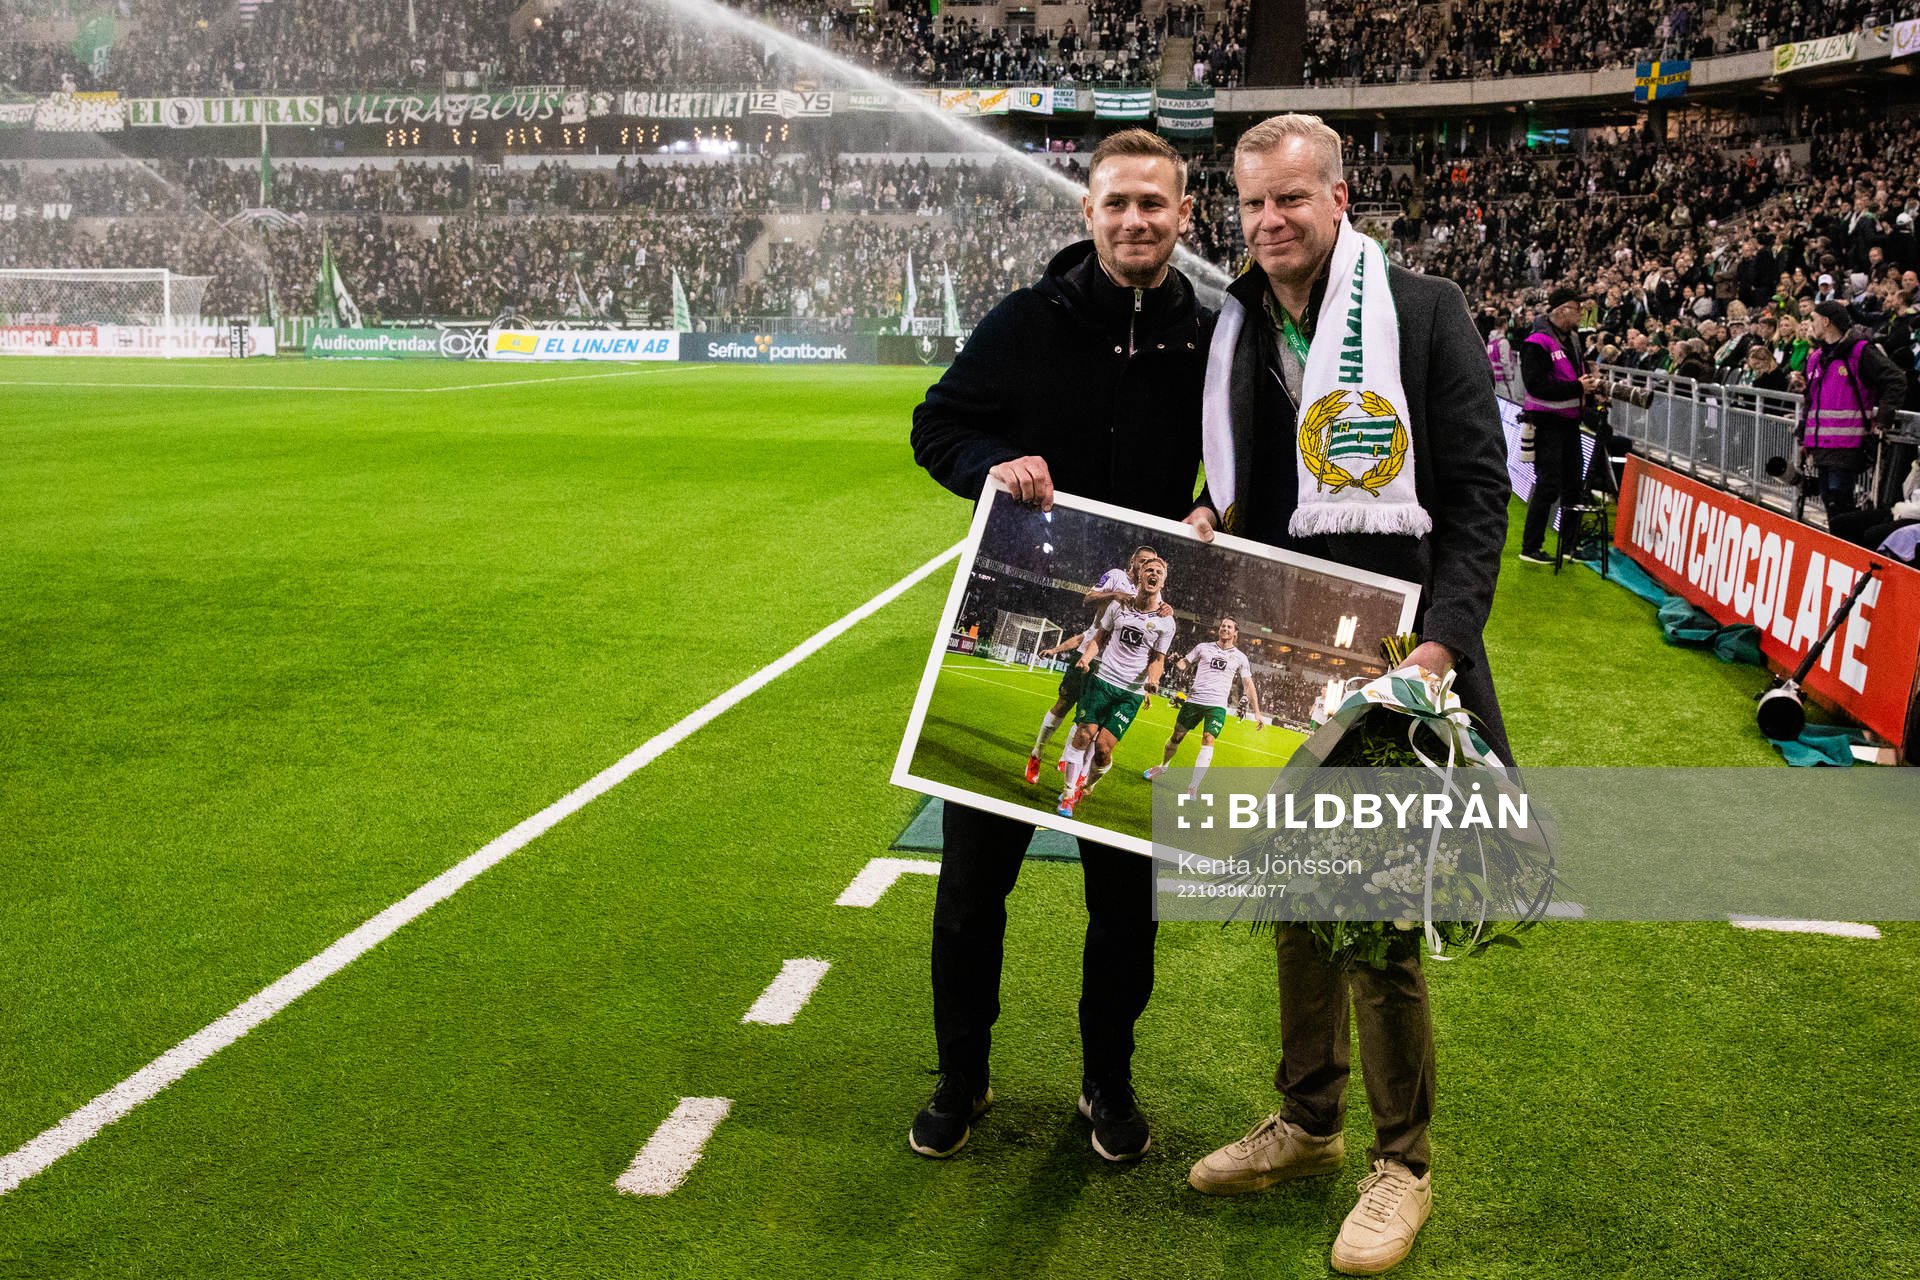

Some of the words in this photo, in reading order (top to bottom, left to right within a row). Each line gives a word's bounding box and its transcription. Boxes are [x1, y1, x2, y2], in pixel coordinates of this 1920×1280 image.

[1793, 32, 1854, 66] BAJEN
[202, 98, 320, 124] ULTRAS
[343, 95, 444, 124] ULTRA
[470, 94, 559, 122] BOYS
[312, 334, 437, 351] AudicomPendax
[544, 338, 565, 353] EL
[572, 338, 639, 353] LINJEN
[642, 338, 670, 353] AB
[707, 341, 757, 359] Sefina
[769, 343, 847, 362] pantbank
[1631, 473, 1694, 576] HUSKI
[1688, 500, 1882, 696] CHOCOLATE
